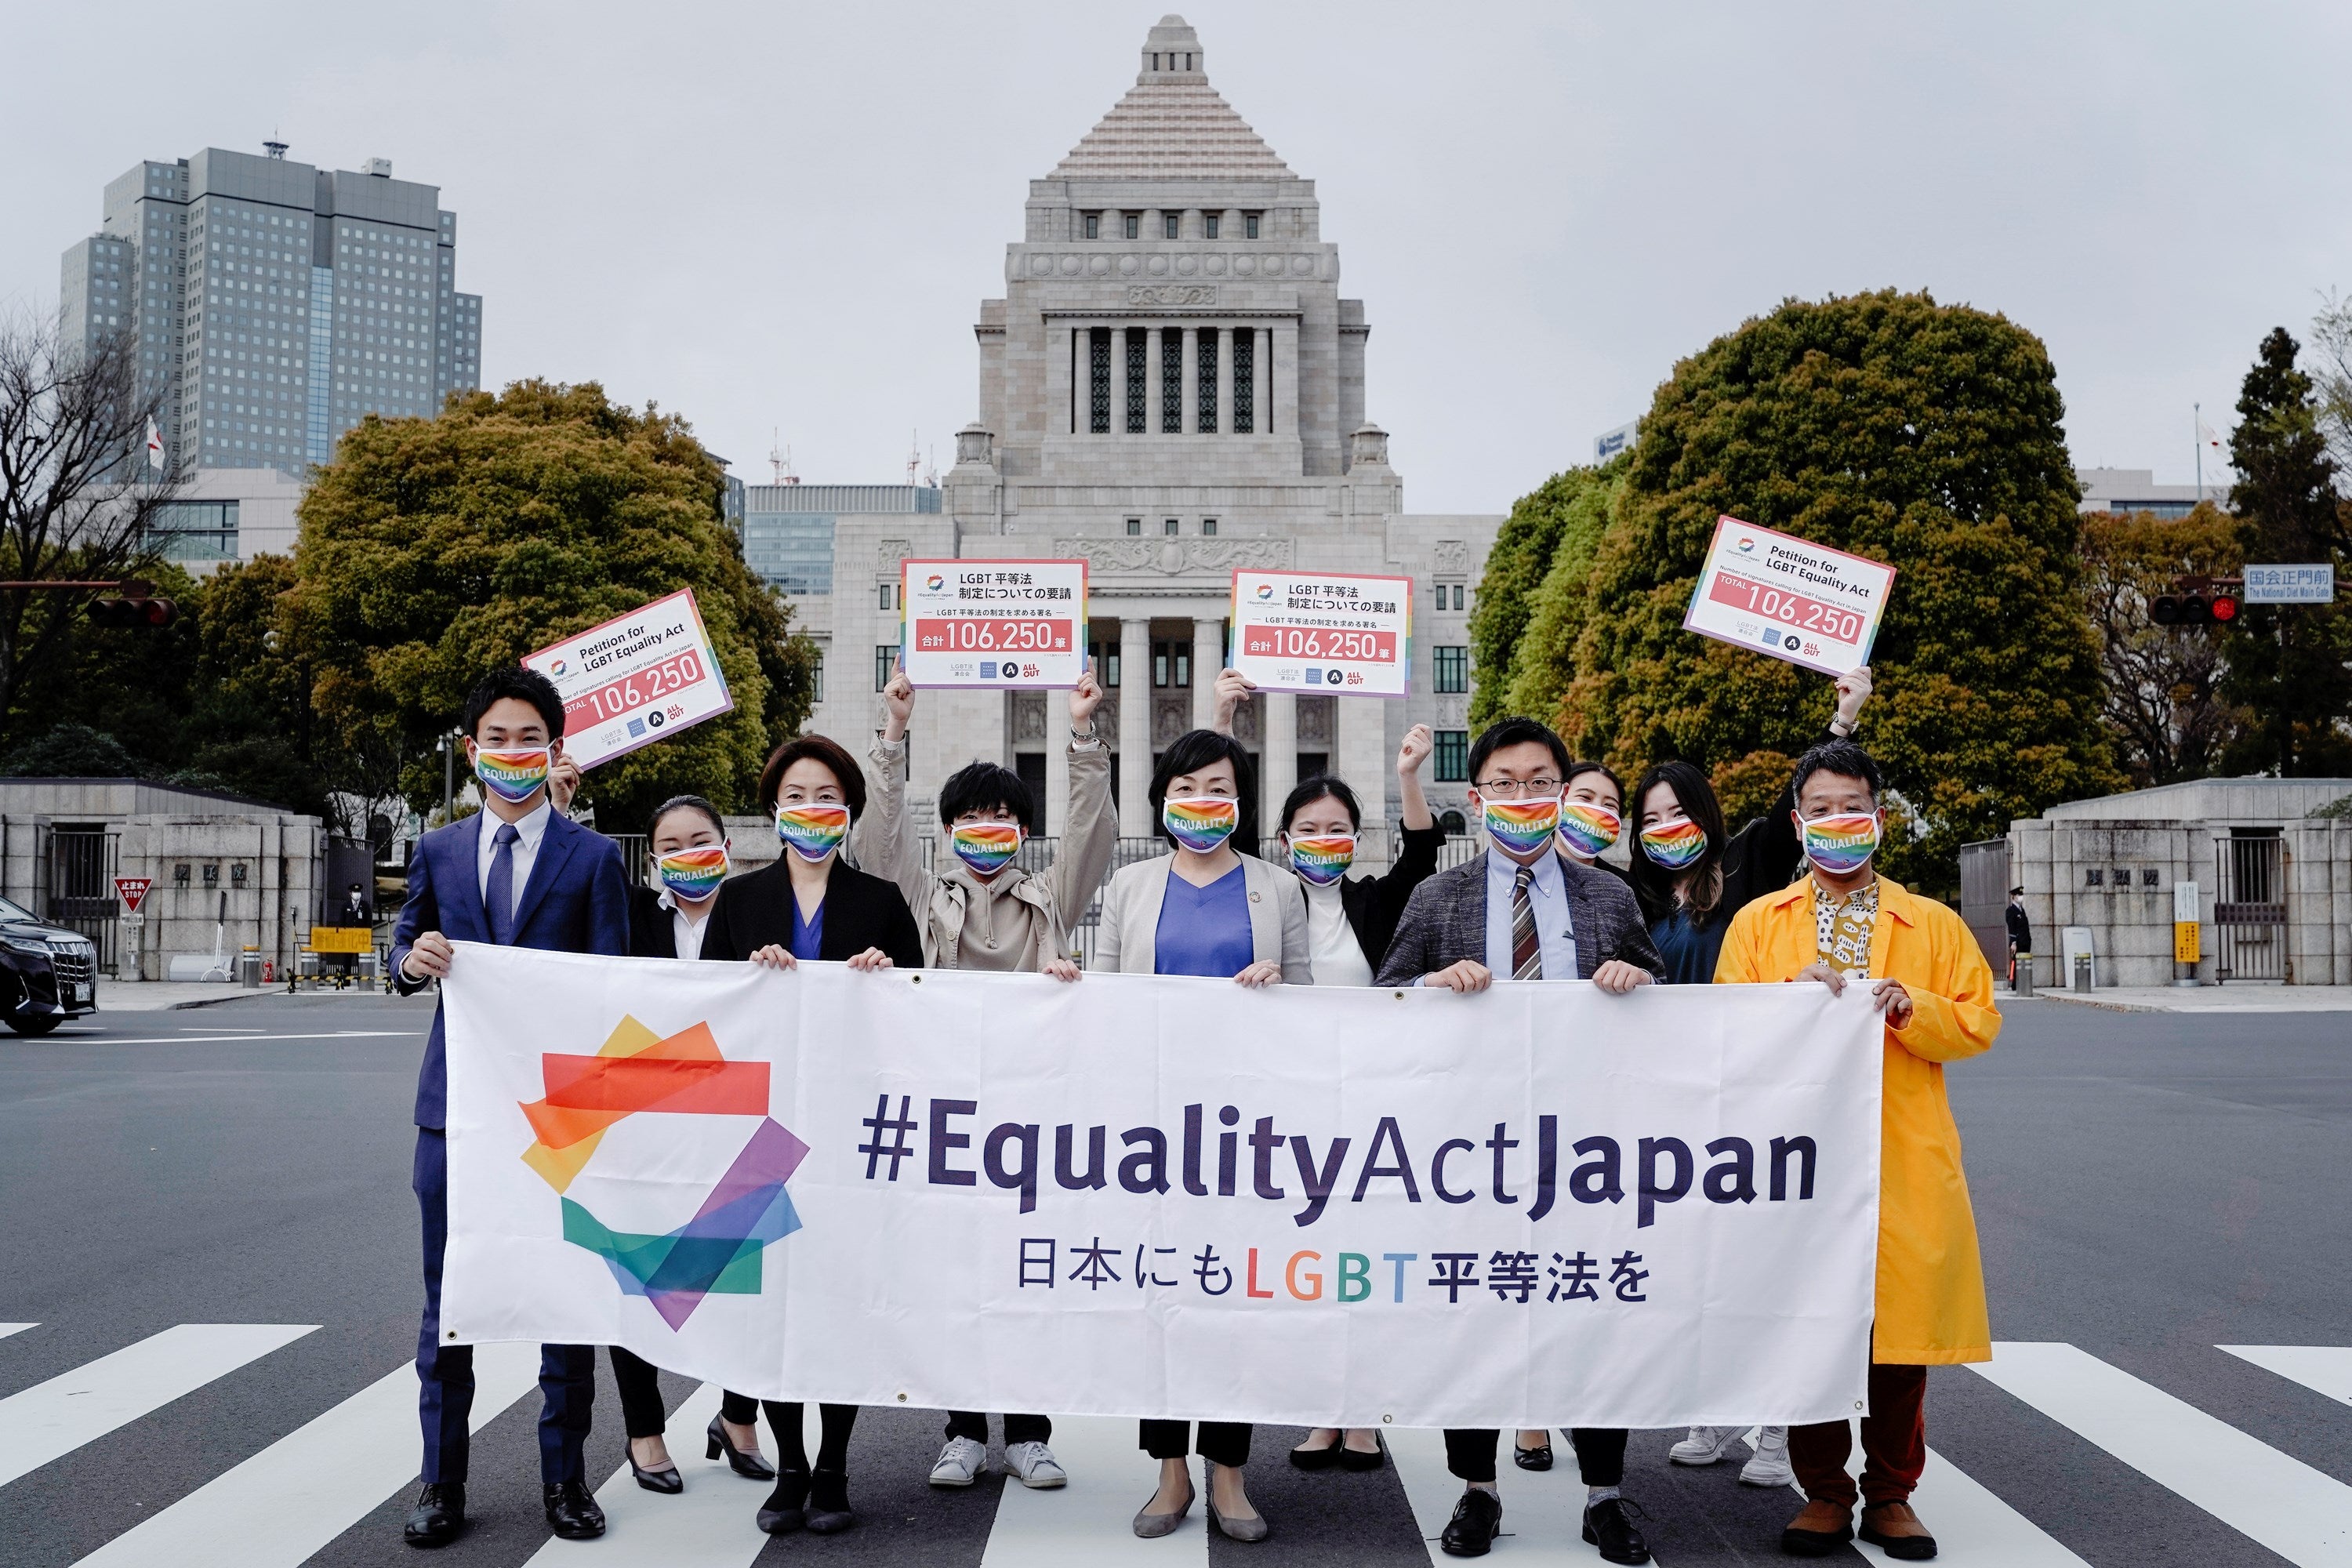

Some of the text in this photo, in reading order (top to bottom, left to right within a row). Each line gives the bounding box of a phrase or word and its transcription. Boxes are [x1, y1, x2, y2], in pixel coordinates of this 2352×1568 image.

[1770, 546, 1817, 566] Petition
[1820, 560, 1838, 574] for
[960, 573, 1032, 584] LGBT 平等法
[1766, 558, 1797, 575] LGBT
[1798, 568, 1848, 592] Equality
[1849, 584, 1870, 598] Act
[2249, 570, 2328, 585] 国会正門前
[959, 588, 1071, 600] 制定についての要請
[1289, 585, 1358, 597] LGBT 平等法
[1720, 565, 1740, 574] Number
[1748, 574, 1774, 586] signatures
[1775, 580, 1791, 592] calling
[1815, 593, 1836, 604] Equality
[1851, 604, 1867, 615] Japan
[2249, 587, 2259, 597] The
[2261, 587, 2285, 597] National
[2300, 587, 2313, 597] Main
[2316, 587, 2329, 597] Gate
[1287, 597, 1396, 614] 制定についての要請
[1719, 575, 1858, 640] TOTAL 106,250
[1287, 618, 1377, 629] 平等法の制定を求める署名
[579, 624, 645, 659] Petition for
[922, 622, 1066, 651] 合計 106,250 筆
[1250, 630, 1390, 659] 合計 106,250 筆
[584, 622, 685, 673] LGBT Equality Act
[579, 681, 605, 695] signatures
[605, 673, 622, 684] calling
[630, 664, 643, 673] LGBT
[644, 656, 664, 668] Equality
[678, 643, 694, 653] Japan
[564, 655, 698, 719] OTAL 106,250
[667, 704, 680, 714] ALL
[670, 708, 684, 720] OUT
[484, 767, 542, 782] EQUALITY
[782, 826, 827, 837] EQUALITY
[1174, 816, 1229, 831] EQUALITY
[1494, 816, 1552, 834] EQUALITY
[1566, 818, 1613, 840] EQUALITY
[960, 842, 1011, 854] EQUALITY
[1650, 836, 1698, 855] EQUALITY
[1813, 832, 1869, 851] EQUALITY
[1299, 852, 1349, 866] EQUALITY
[669, 865, 720, 882] EQUALITY
[121, 881, 145, 890] 止まれ
[858, 1093, 1817, 1229] #EqualityActJapan
[1018, 1236, 1650, 1305] 日本にもLGBT平等法を
